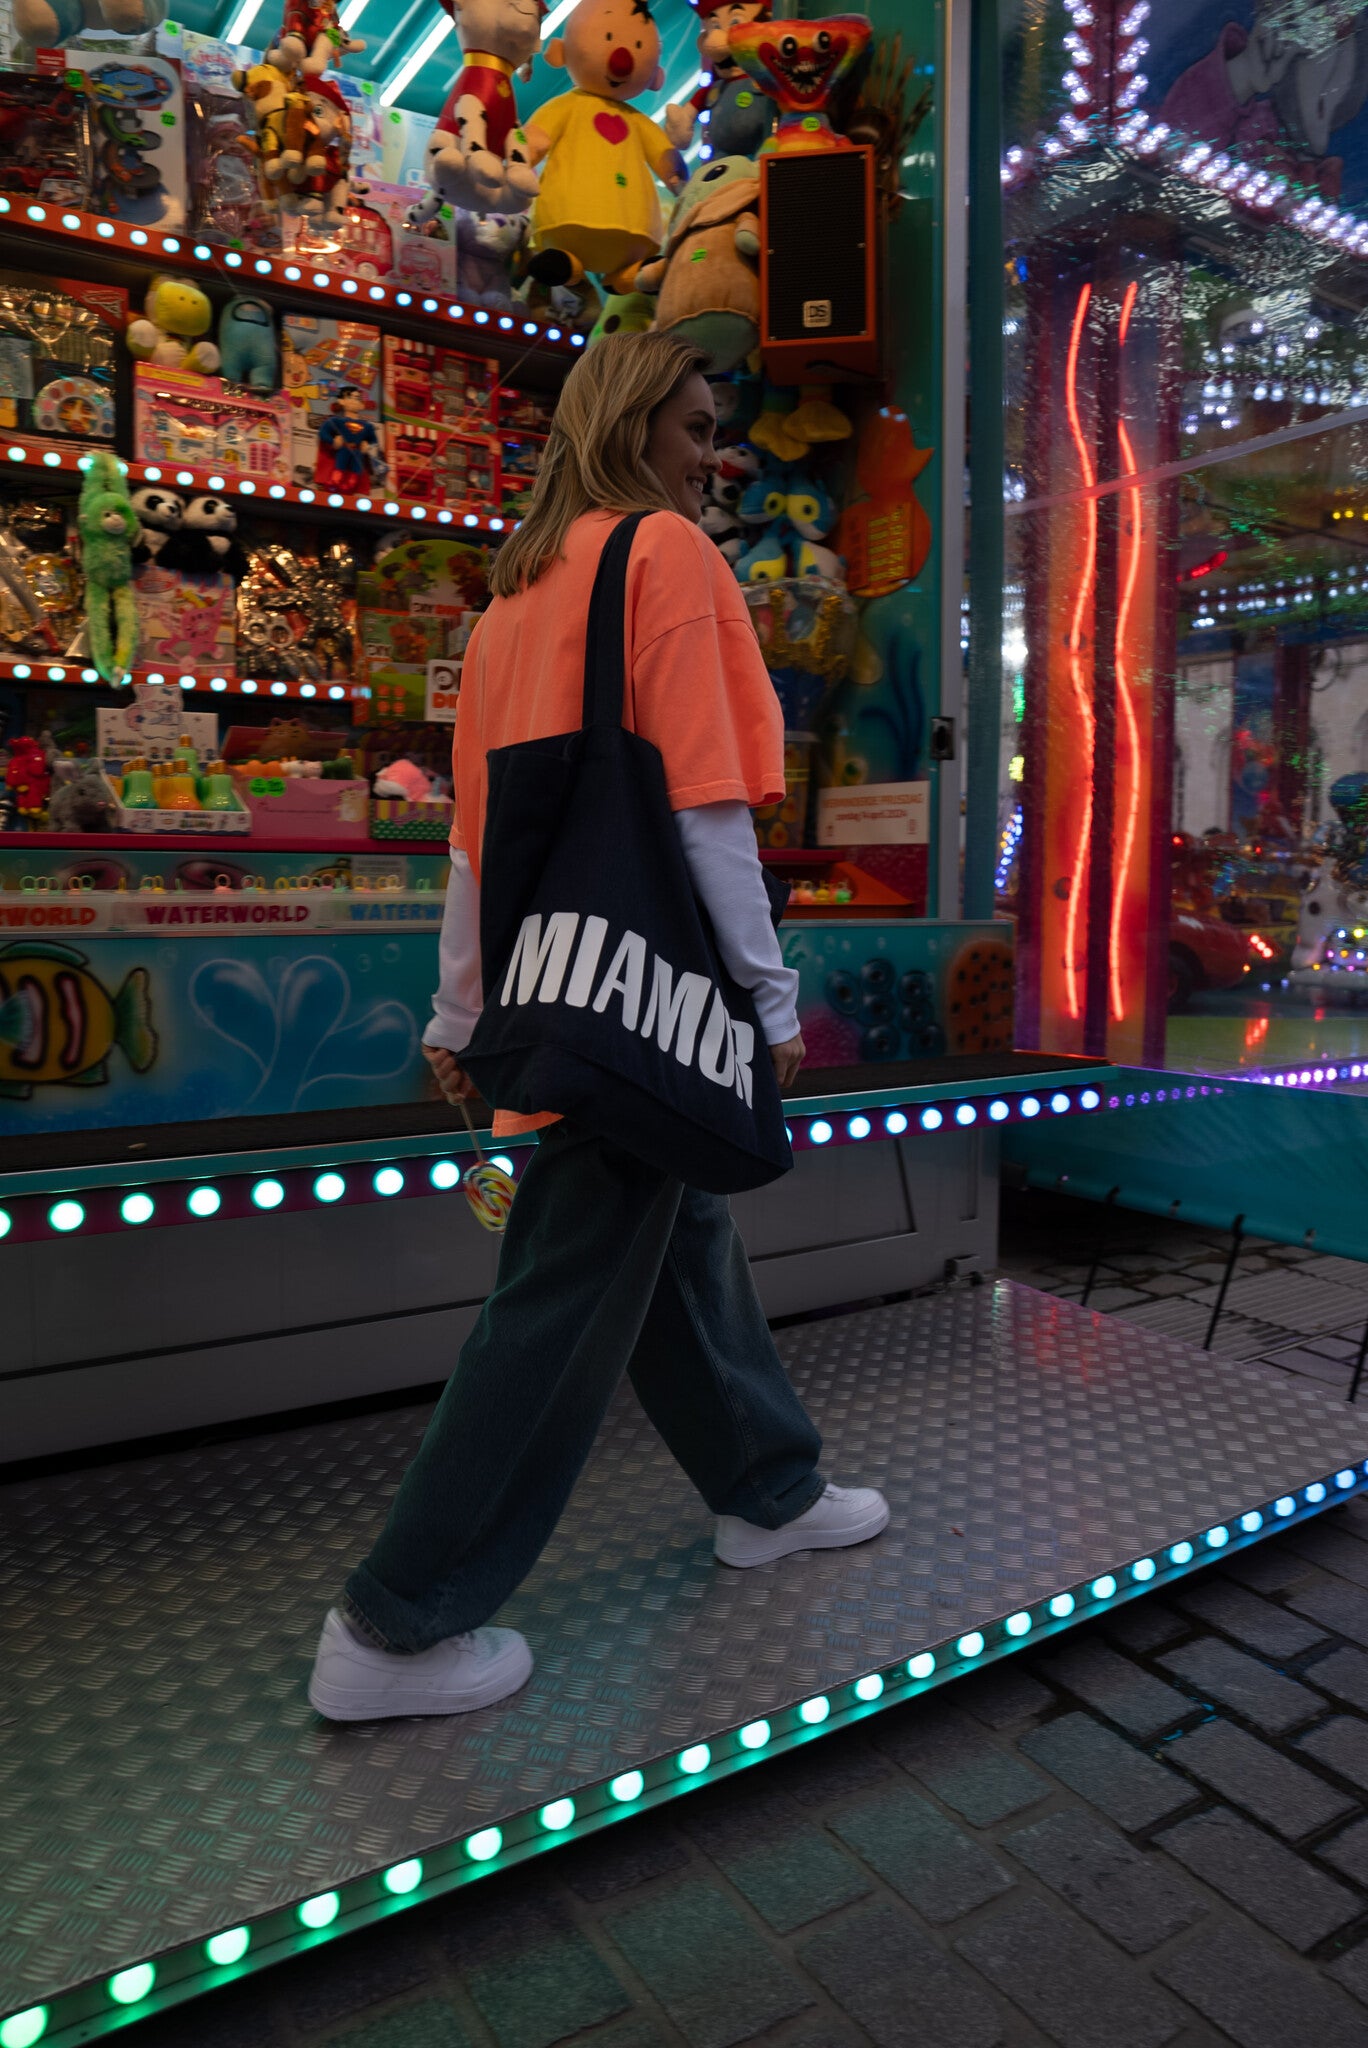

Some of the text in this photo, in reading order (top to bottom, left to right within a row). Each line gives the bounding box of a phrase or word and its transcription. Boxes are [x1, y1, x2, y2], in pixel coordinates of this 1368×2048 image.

[809, 304, 827, 317] DS
[0, 906, 96, 926] WORLD
[146, 905, 310, 925] WATERWORLD
